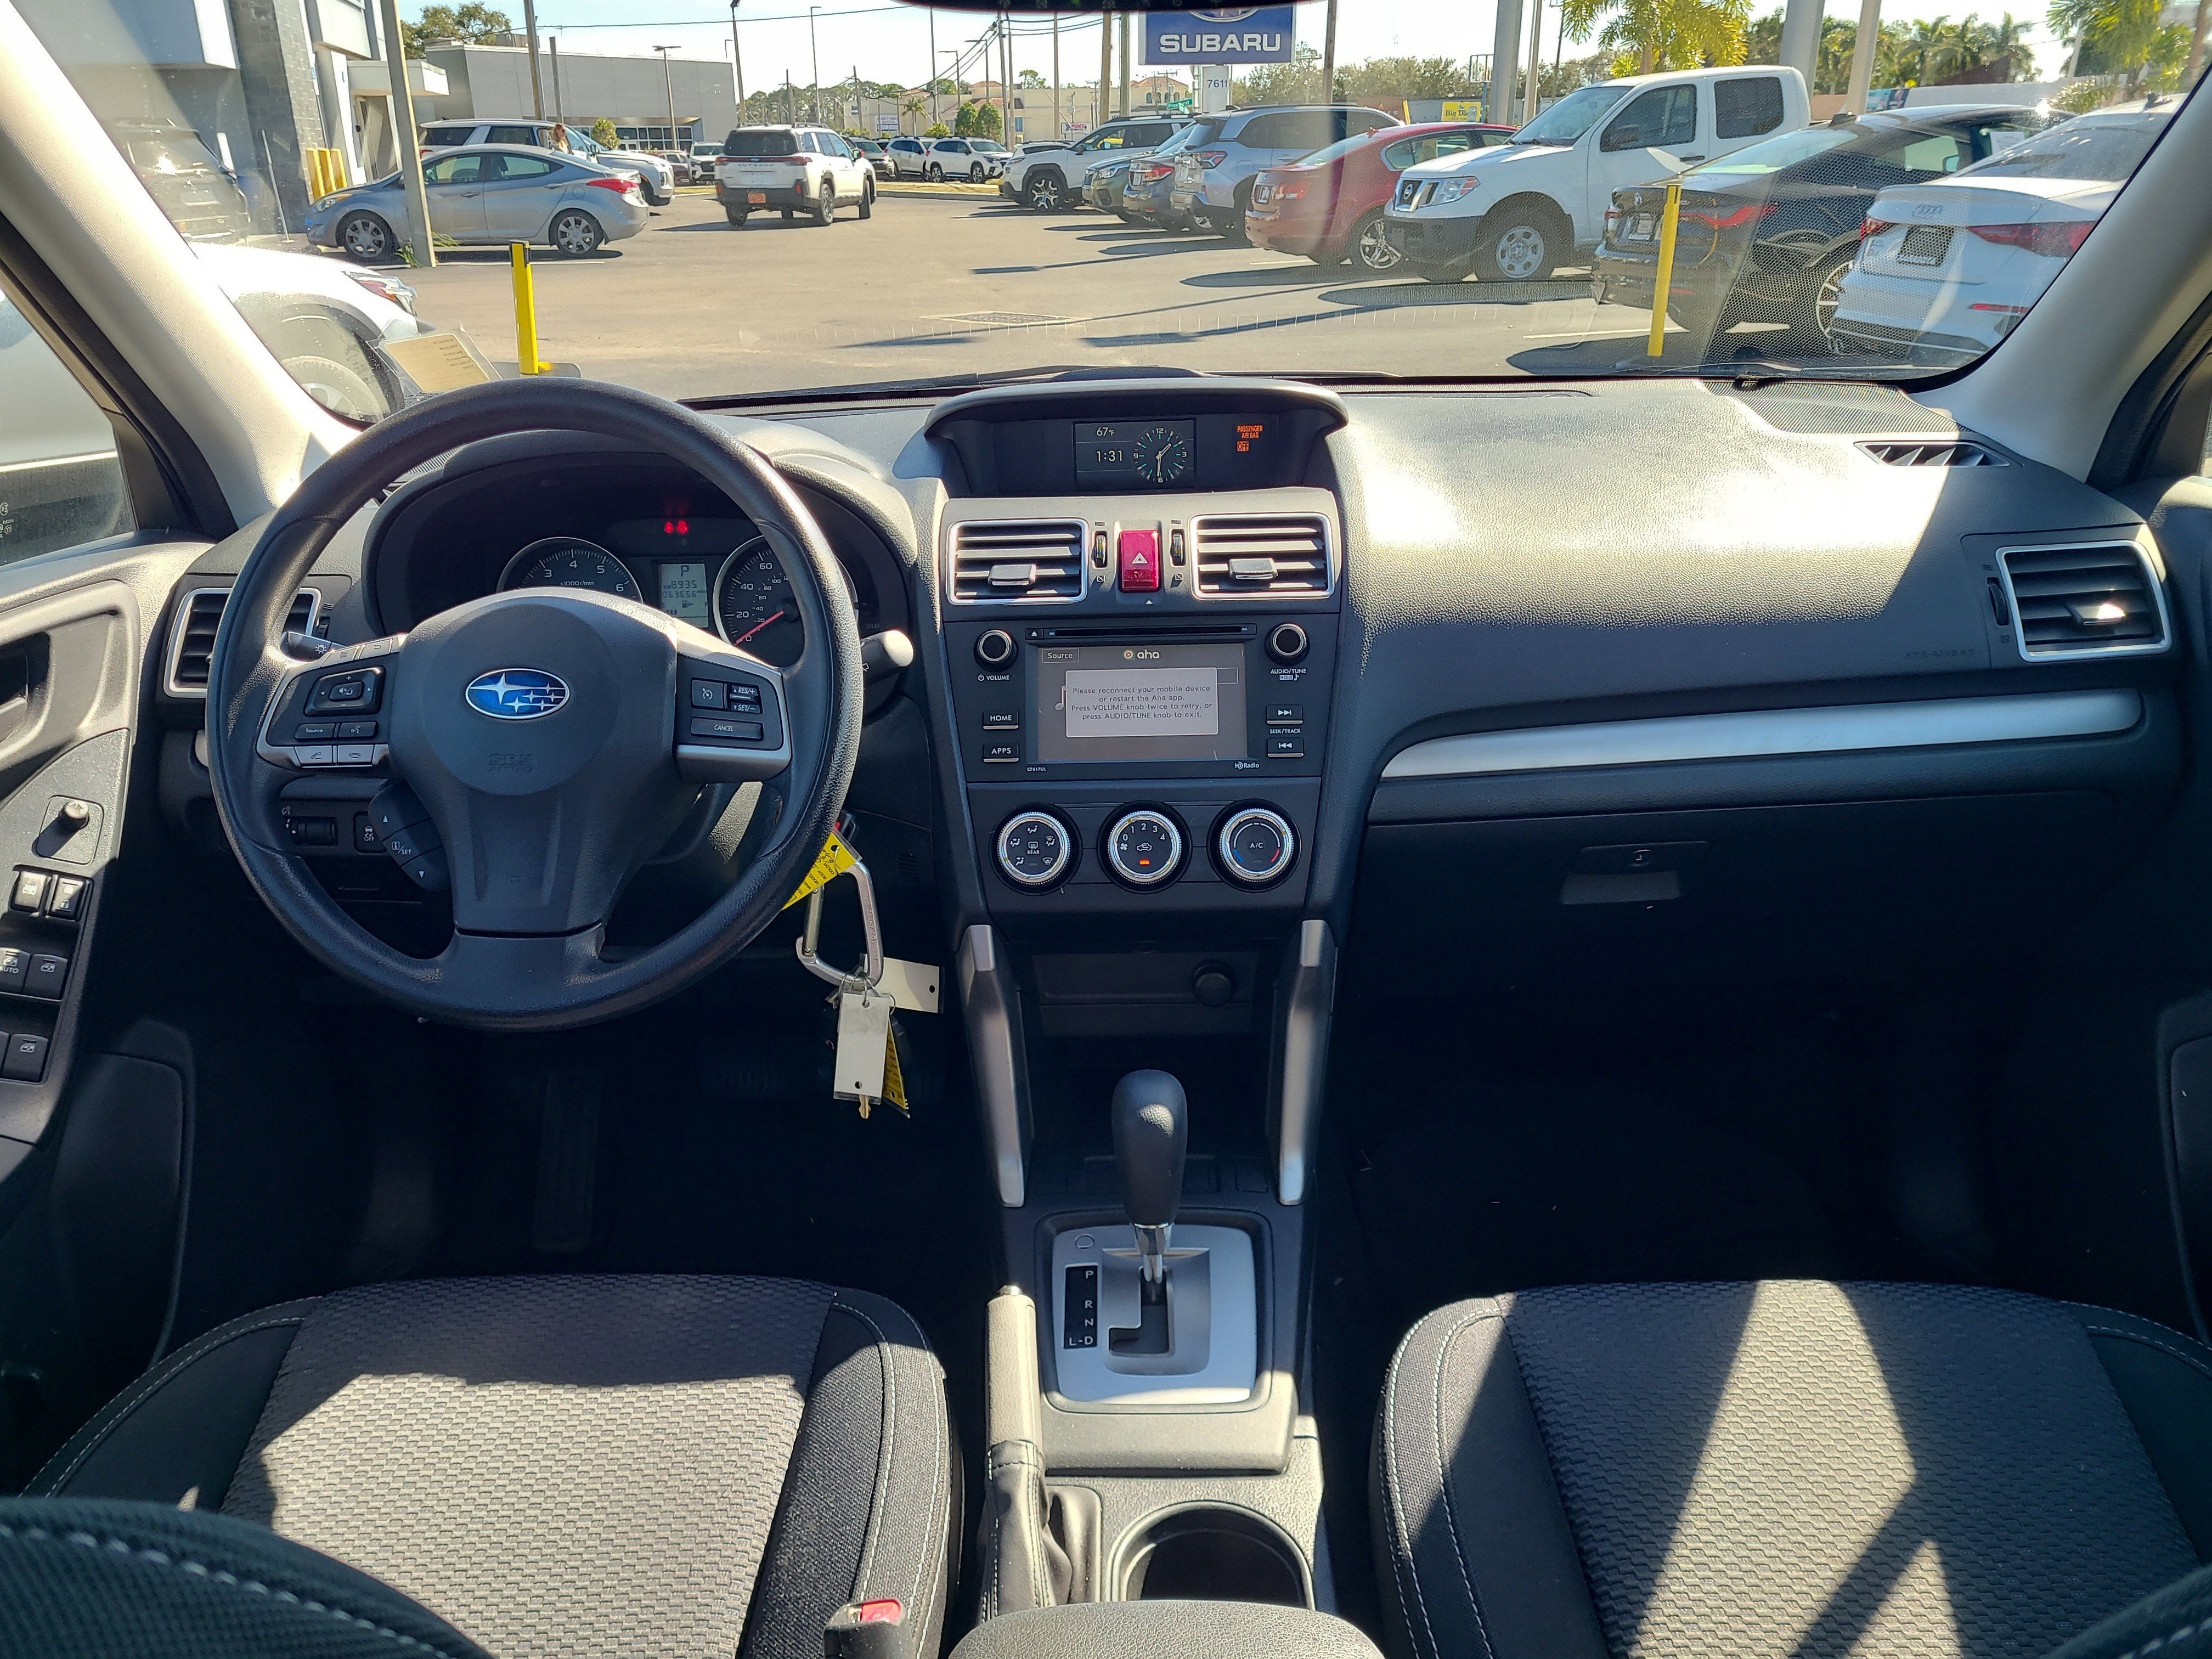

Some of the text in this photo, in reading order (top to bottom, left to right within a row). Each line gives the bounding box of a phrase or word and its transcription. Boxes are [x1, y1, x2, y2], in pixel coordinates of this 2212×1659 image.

[1160, 33, 1280, 53] SUBARU
[1207, 79, 1228, 88] 7611
[1238, 442, 1248, 450] OFF
[1096, 450, 1123, 462] 1:31
[569, 560, 577, 568] 4
[597, 566, 605, 574] 5
[681, 565, 690, 577] P
[616, 583, 624, 591] 6
[1137, 649, 1160, 659] aha
[817, 871, 827, 879] BODY
[1085, 1271, 1094, 1279] P
[1085, 1300, 1093, 1309] R
[1085, 1318, 1094, 1327] N
